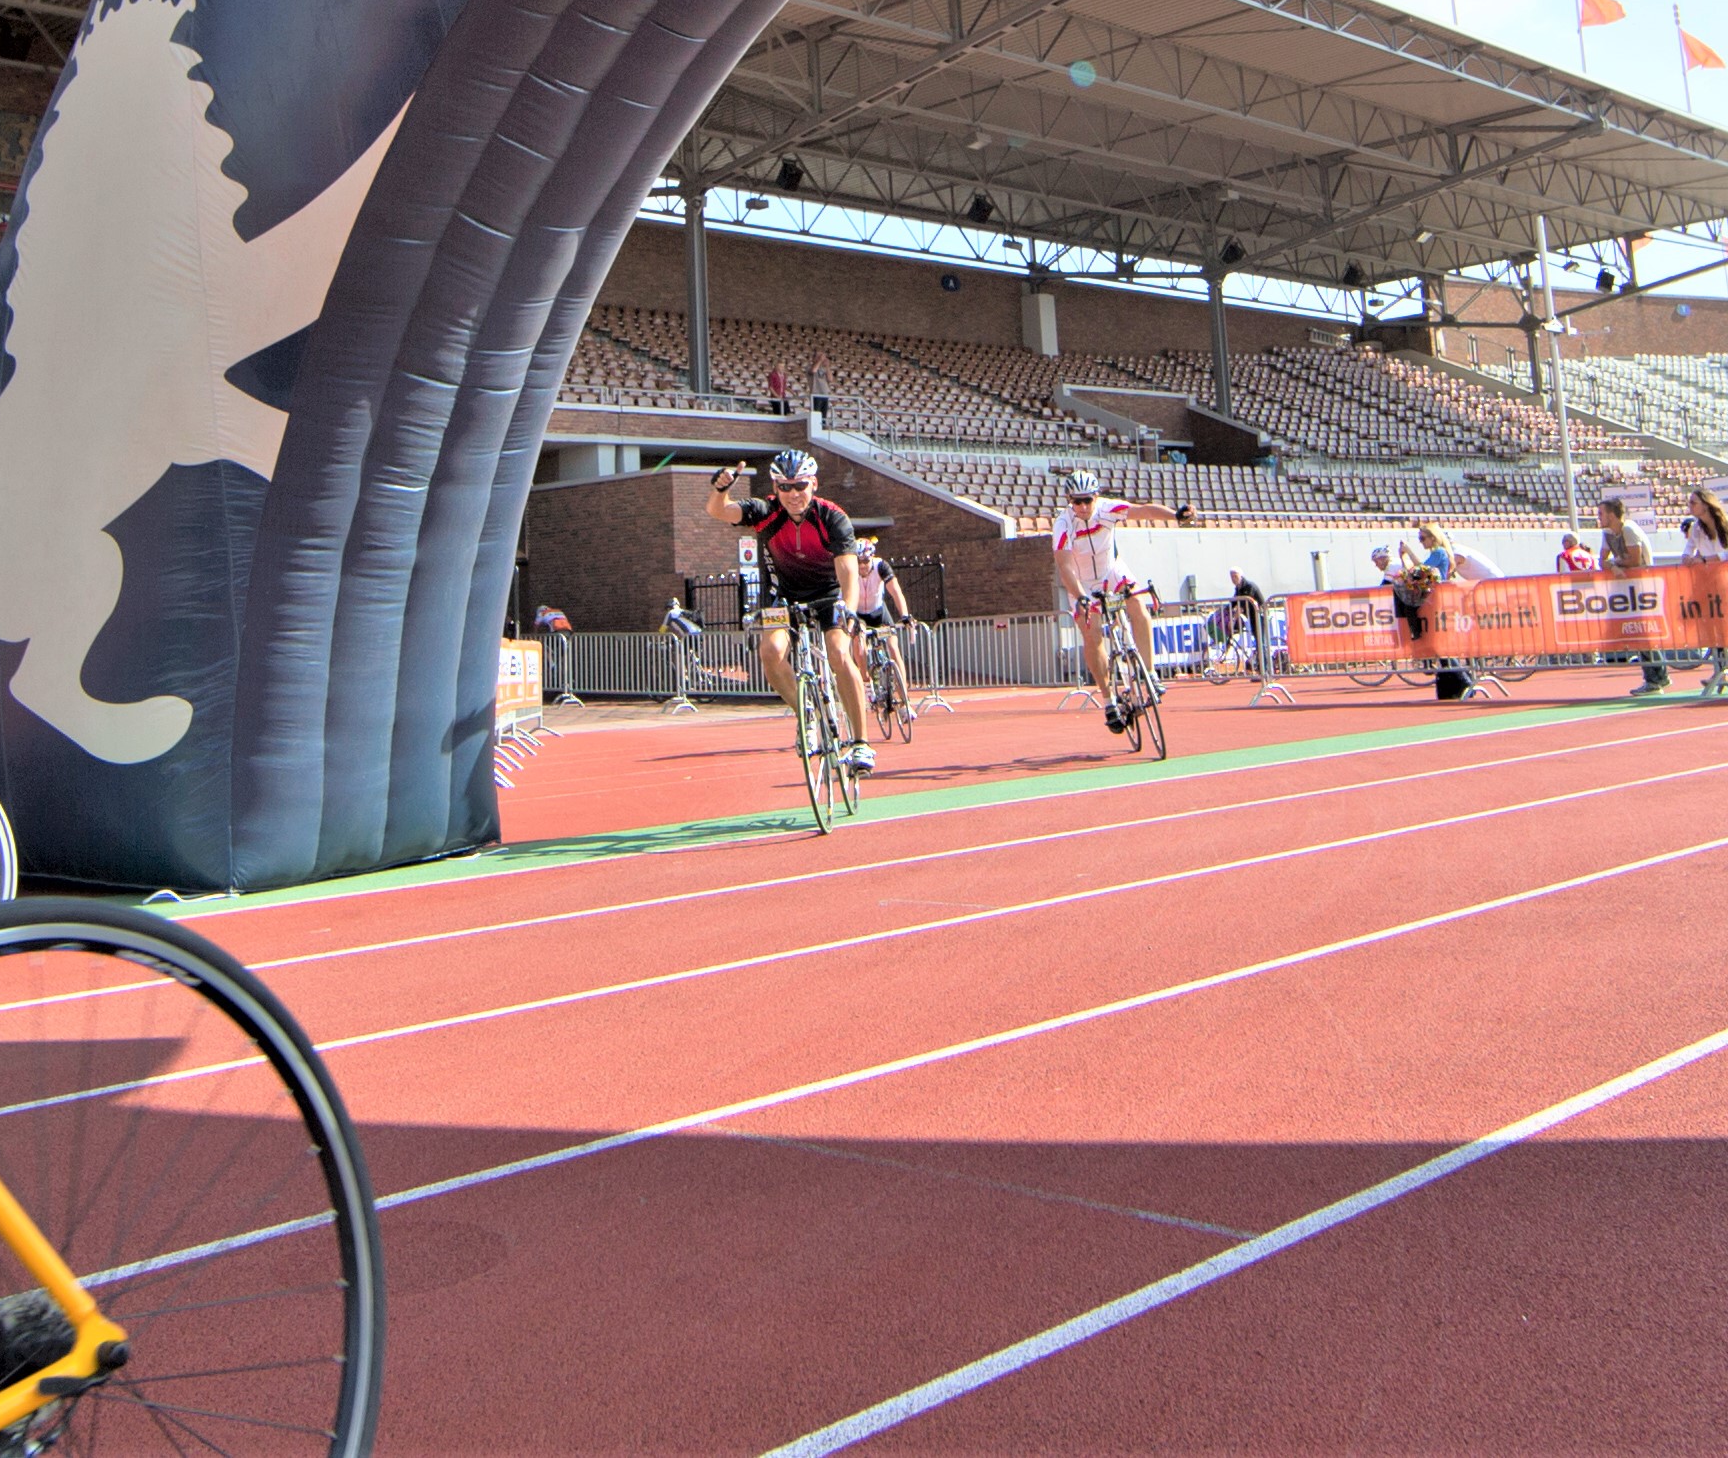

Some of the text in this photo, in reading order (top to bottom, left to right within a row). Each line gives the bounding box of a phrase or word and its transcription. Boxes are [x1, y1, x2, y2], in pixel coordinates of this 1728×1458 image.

[1557, 585, 1658, 616] Boels
[1680, 595, 1702, 620] in
[1709, 593, 1724, 619] it
[1305, 603, 1395, 630] Boels
[1435, 607, 1448, 633] it
[1454, 610, 1471, 633] to
[1477, 606, 1512, 630] win
[1519, 605, 1538, 629] it!
[1622, 619, 1661, 635] RENTAL
[1363, 634, 1395, 648] RENTAL
